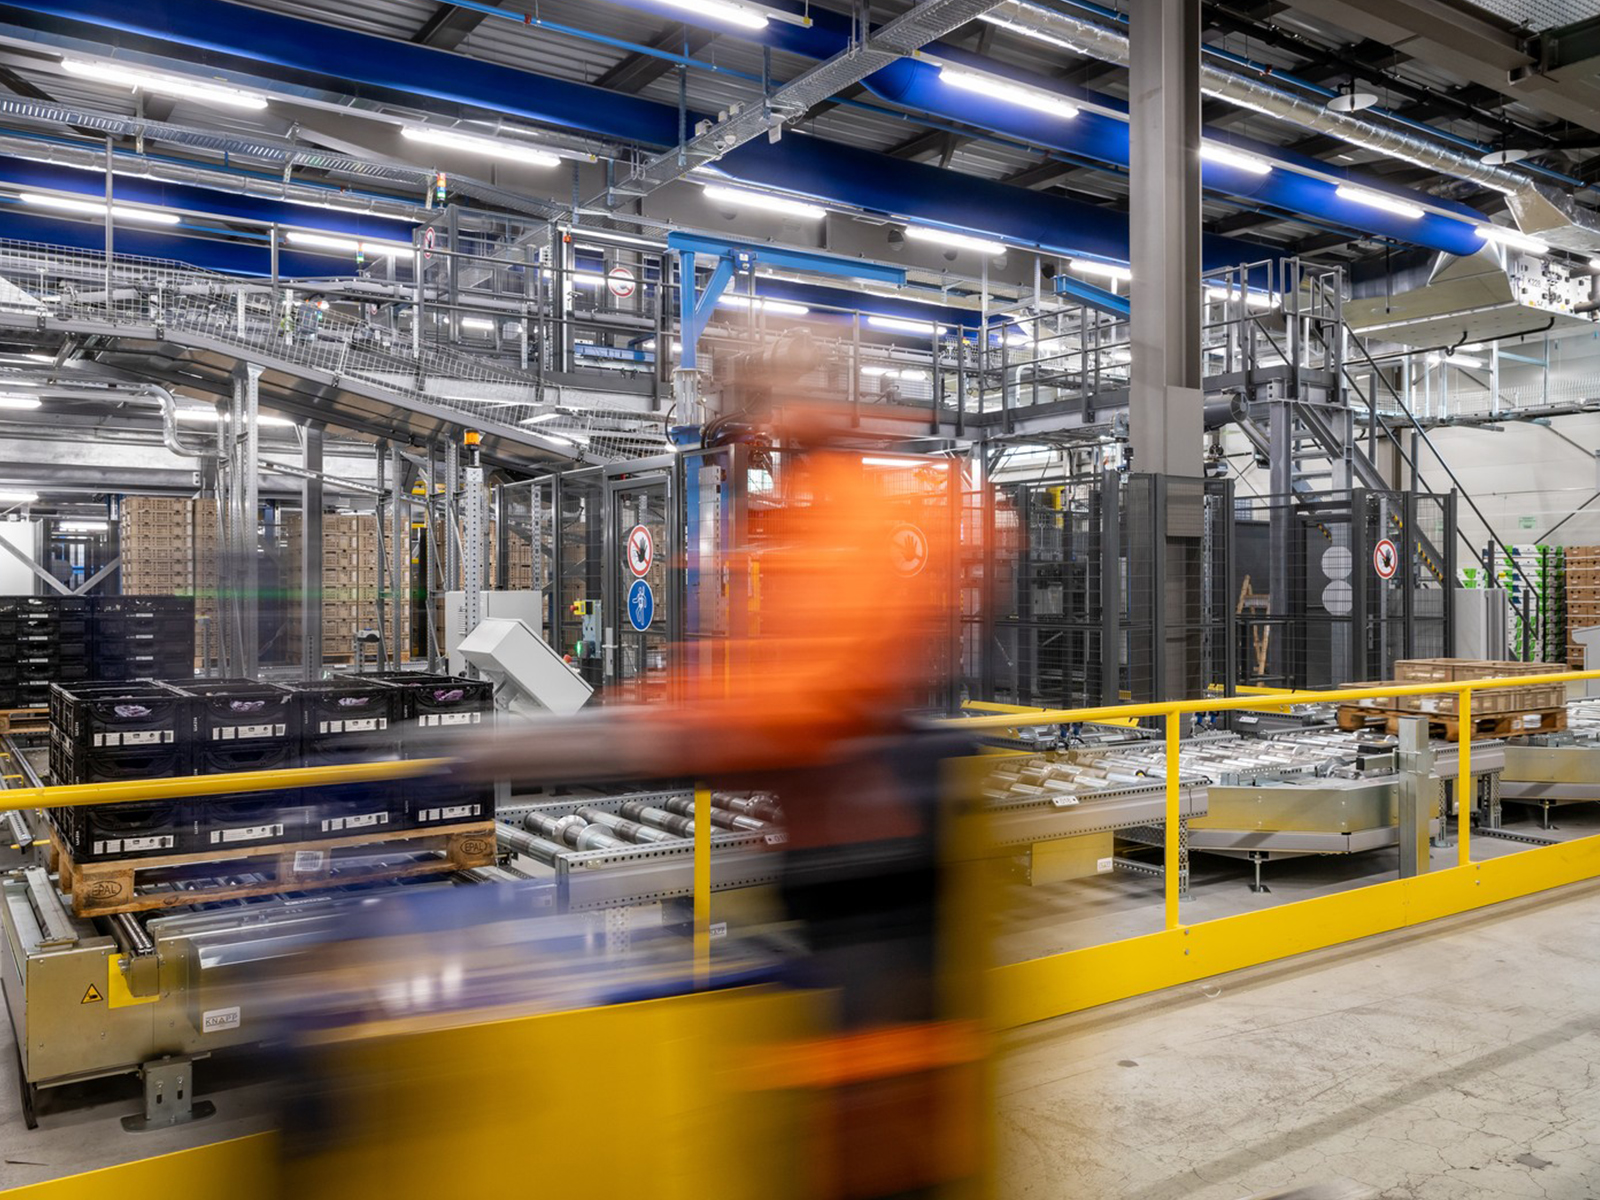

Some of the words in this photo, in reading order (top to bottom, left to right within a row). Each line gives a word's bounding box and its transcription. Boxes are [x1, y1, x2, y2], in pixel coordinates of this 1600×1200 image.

[464, 842, 484, 852] EPAL
[92, 883, 117, 897] EPAL
[205, 1013, 238, 1027] KNAPP
